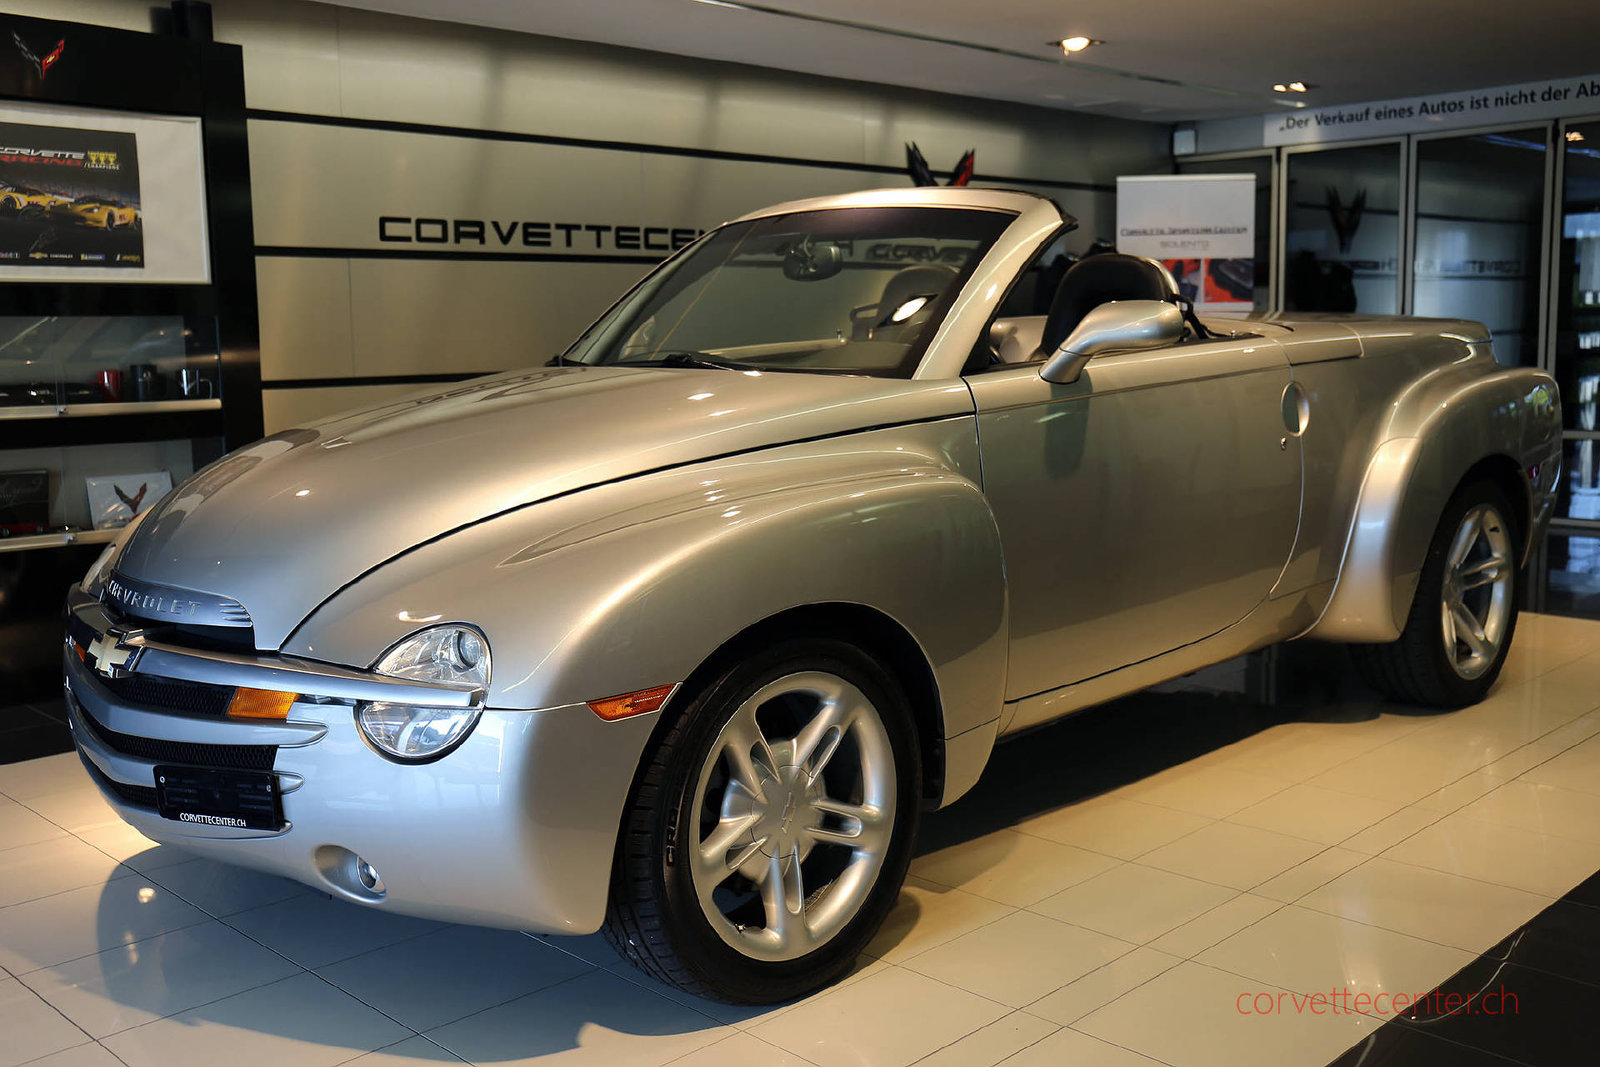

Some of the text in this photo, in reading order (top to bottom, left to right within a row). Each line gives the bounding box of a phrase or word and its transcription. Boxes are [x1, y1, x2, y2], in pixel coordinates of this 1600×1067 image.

[1315, 107, 1370, 126] Verkauf
[1374, 104, 1414, 121] eines
[1418, 100, 1465, 116] Autos
[1470, 95, 1489, 111] ist
[1494, 90, 1537, 108] nicht
[1541, 85, 1571, 104] der
[0, 146, 85, 160] ORVETTE
[379, 216, 705, 250] CORVETTECE
[108, 580, 201, 616] CHEVROLET
[179, 812, 247, 828] CORVETTECENTER.CH
